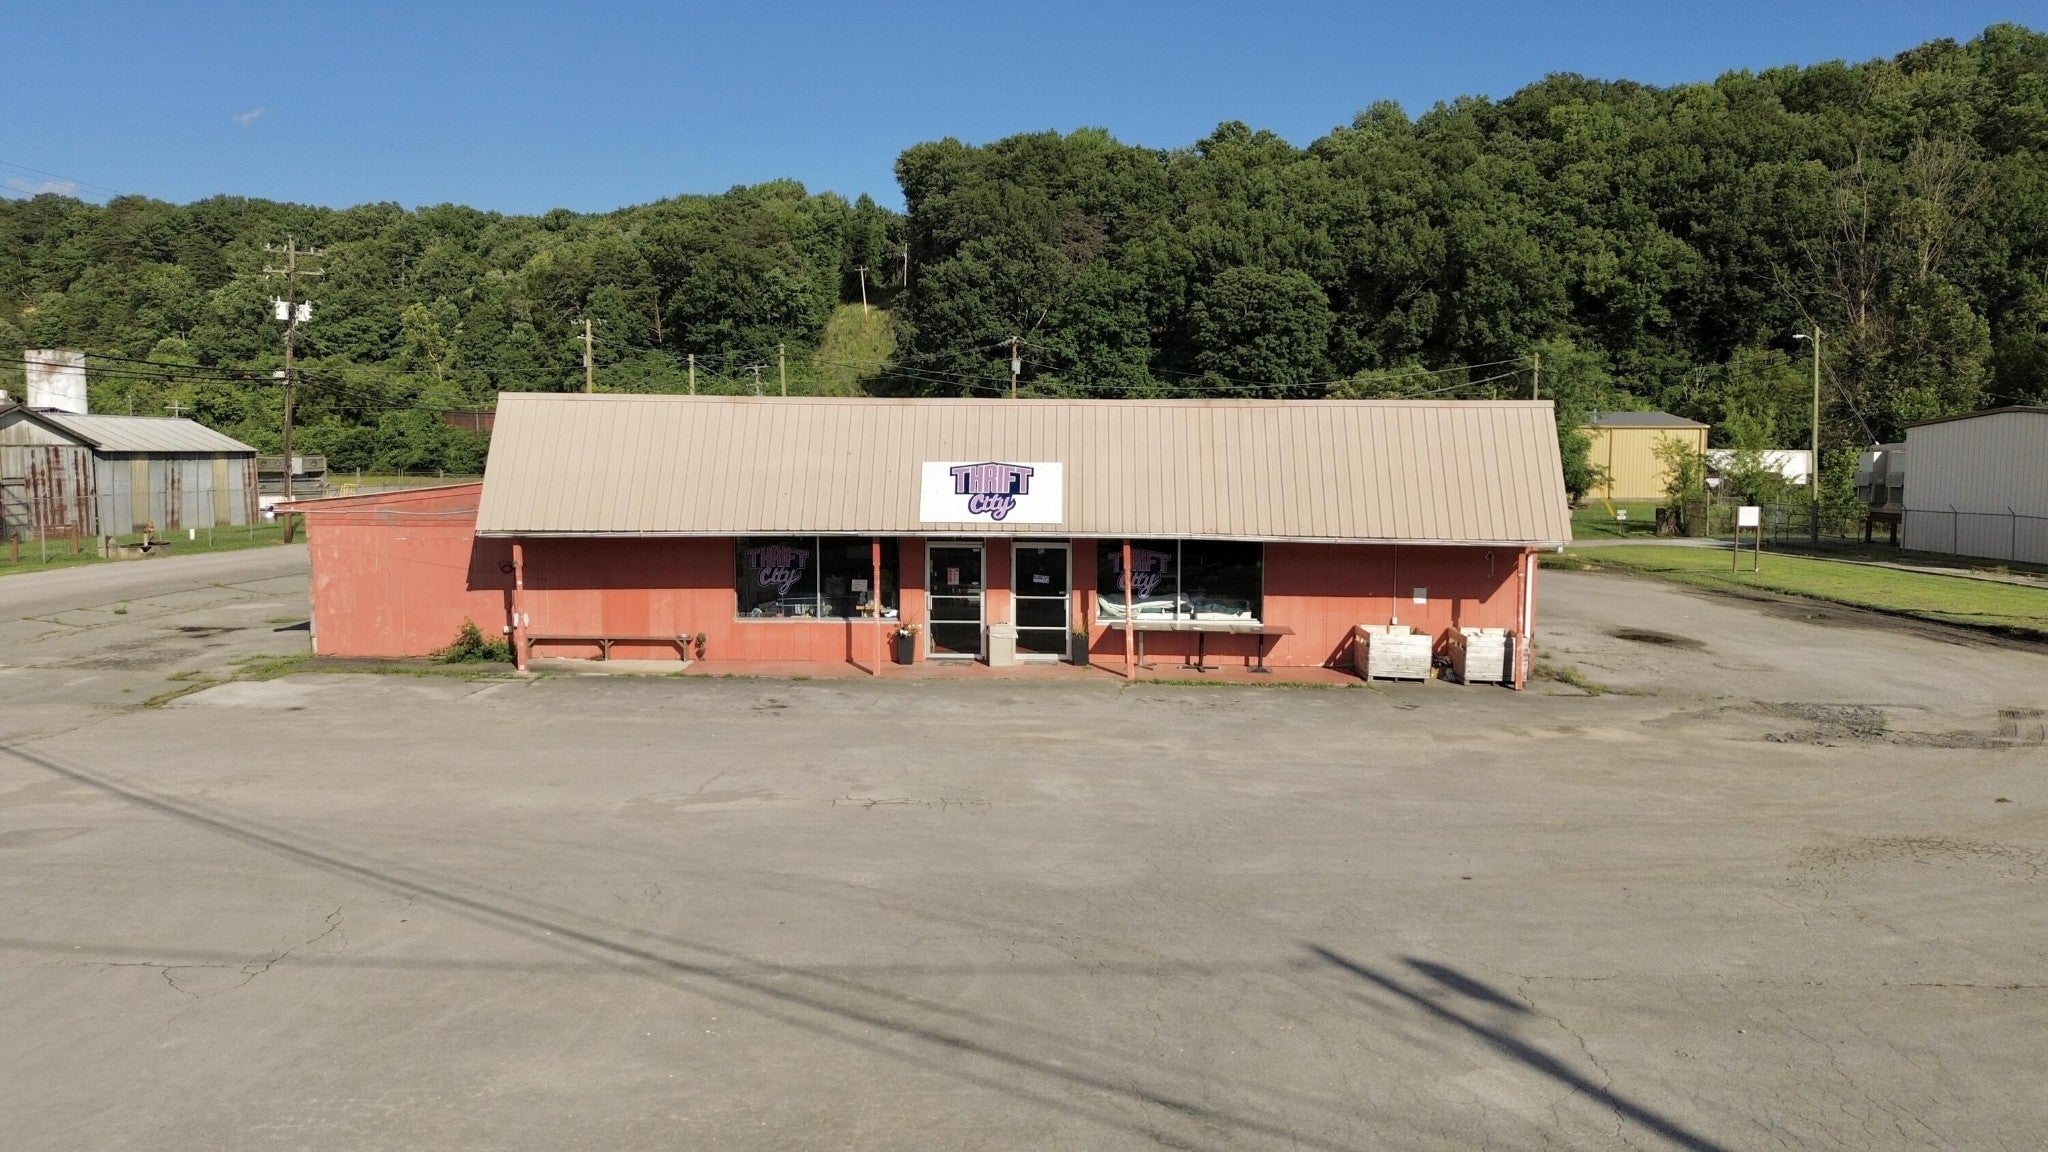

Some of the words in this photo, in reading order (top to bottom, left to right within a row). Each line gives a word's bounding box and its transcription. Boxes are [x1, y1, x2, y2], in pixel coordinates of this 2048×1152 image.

[951, 462, 1034, 494] THRIFT
[968, 493, 1016, 521] City
[747, 545, 809, 568] THRIFT
[759, 567, 802, 595] City
